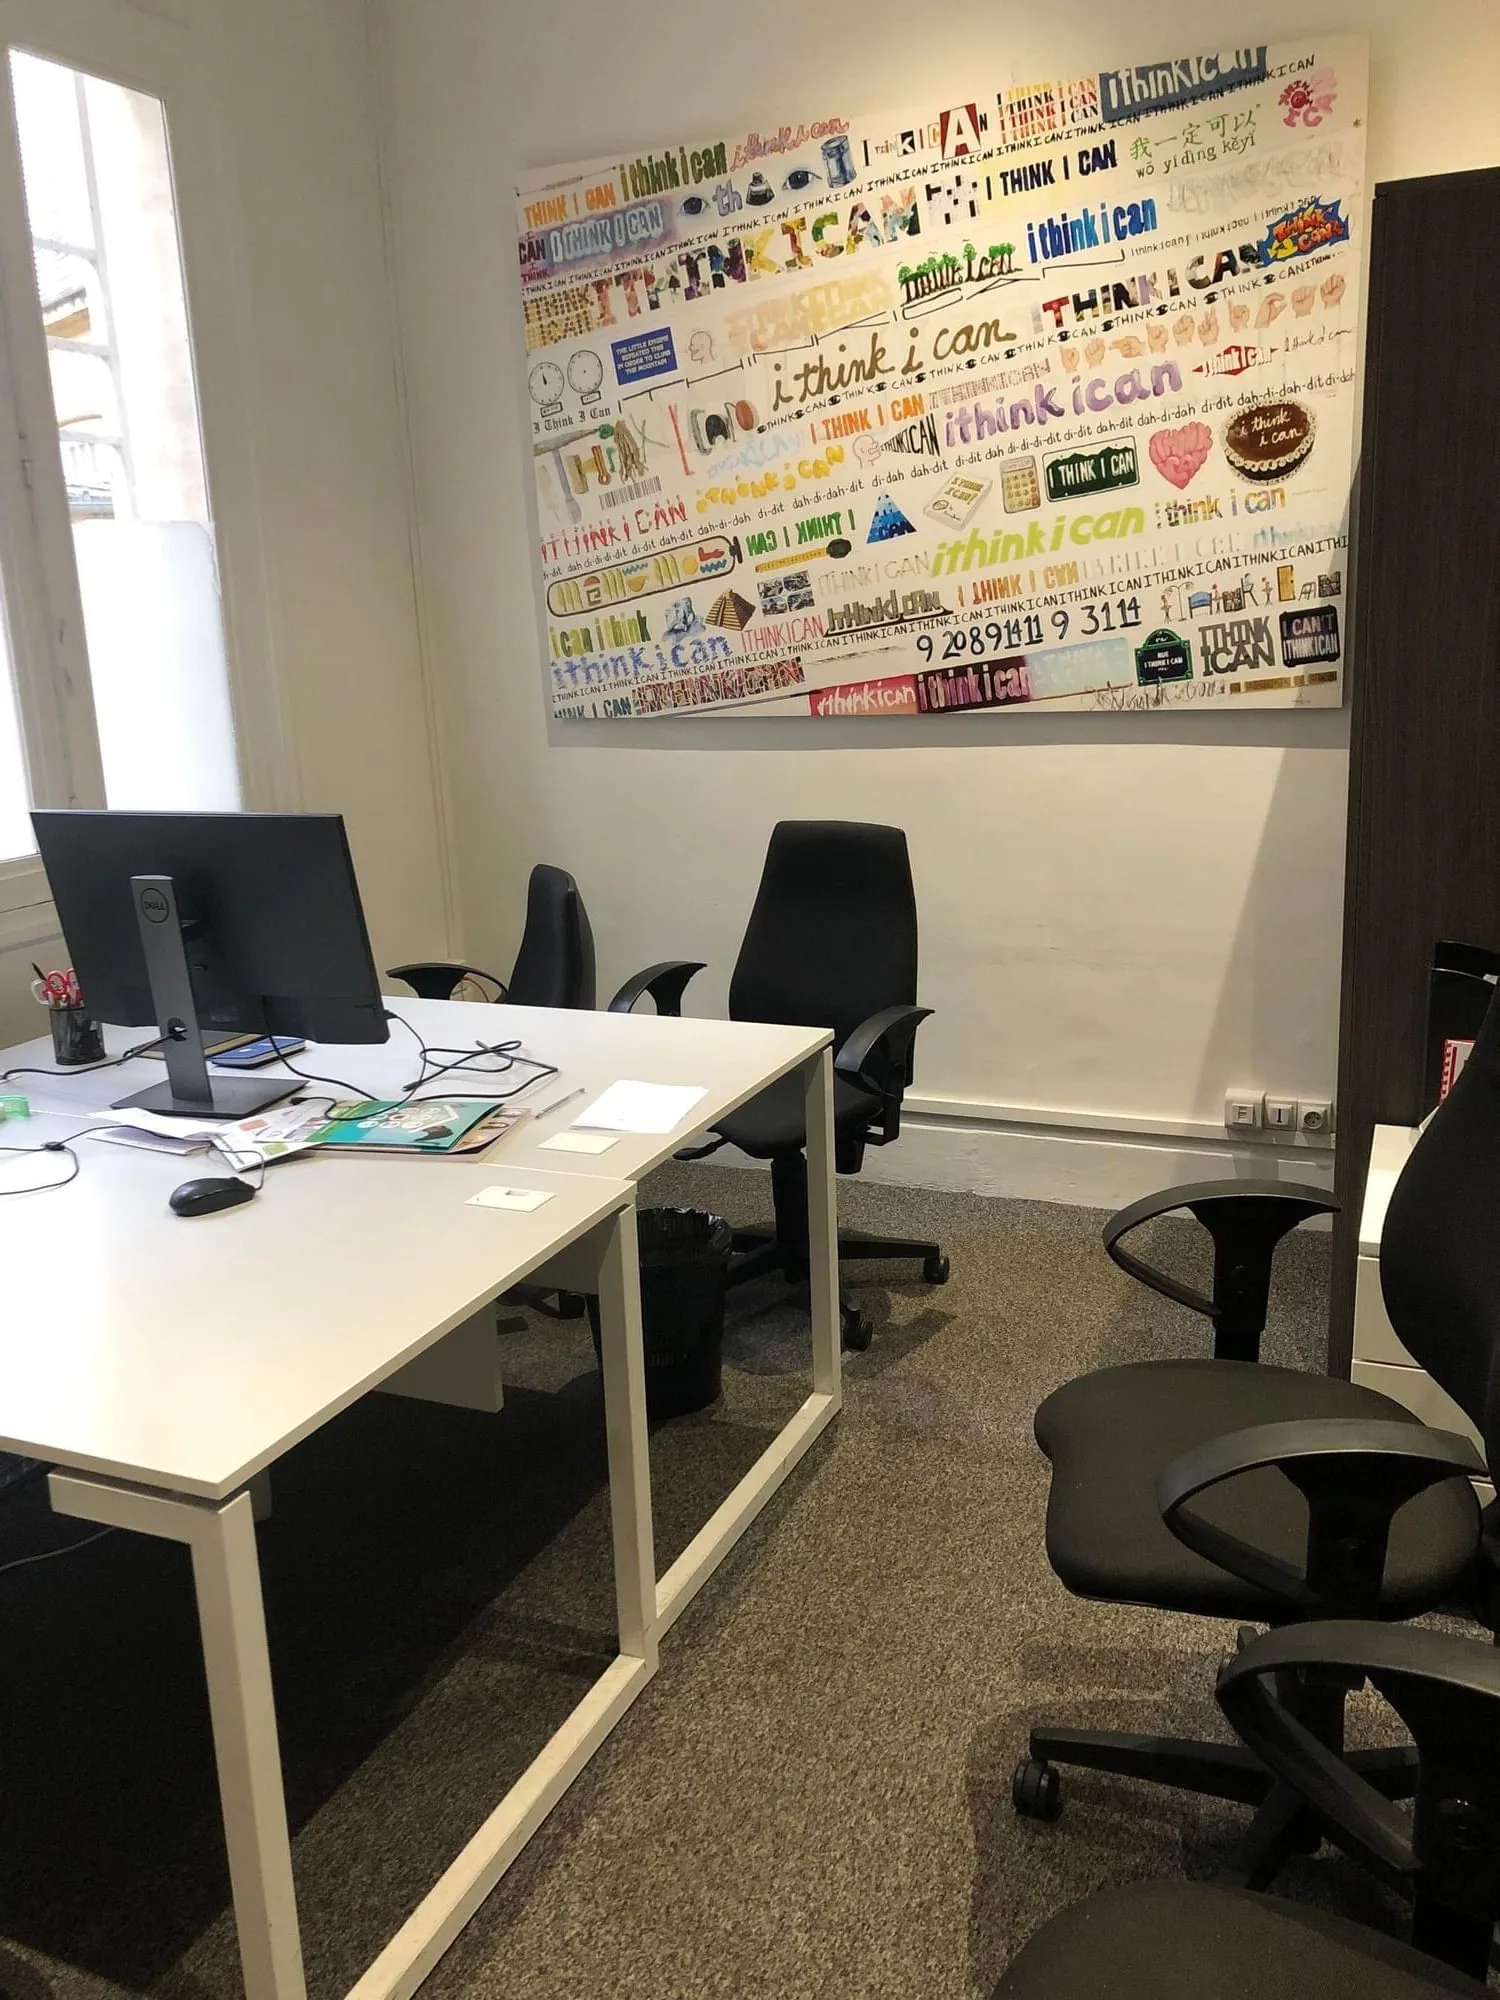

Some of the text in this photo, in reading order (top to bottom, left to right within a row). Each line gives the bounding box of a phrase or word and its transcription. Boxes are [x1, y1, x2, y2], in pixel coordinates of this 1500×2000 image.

[1006, 89, 1055, 115] THINK
[1068, 77, 1097, 97] CAN
[1009, 103, 1056, 128] THINK
[1069, 90, 1098, 109] CAN
[1070, 104, 1099, 123] CAN
[1000, 159, 1056, 197] THINK
[1078, 138, 1119, 177] CAN
[524, 193, 569, 229] THINK
[585, 182, 617, 212] CAN
[518, 237, 547, 265] CAN
[1042, 271, 1164, 329] THINK
[772, 318, 1018, 412] i think i can
[544, 415, 574, 432] Think
[821, 406, 873, 441] THINK
[890, 393, 926, 422] CAN
[1251, 409, 1293, 433] think
[1271, 428, 1302, 445] can
[631, 540, 657, 557] di-dit
[659, 529, 695, 548] dah-dit
[697, 514, 752, 537] dah-di-dah
[757, 503, 786, 520] di-dit
[871, 470, 906, 490] di-dah
[910, 460, 950, 480] dah-dit
[955, 451, 983, 470] di-dit
[984, 444, 1005, 462] dah
[1064, 425, 1094, 443] di-dit
[1096, 415, 1135, 435] dah-dit
[1137, 405, 1197, 429] dah-di-dah
[1201, 395, 1235, 414] di-dit
[1058, 458, 1097, 487] THINK
[1110, 450, 1135, 476] CAN
[1243, 487, 1287, 515] can
[603, 696, 633, 719] CAN
